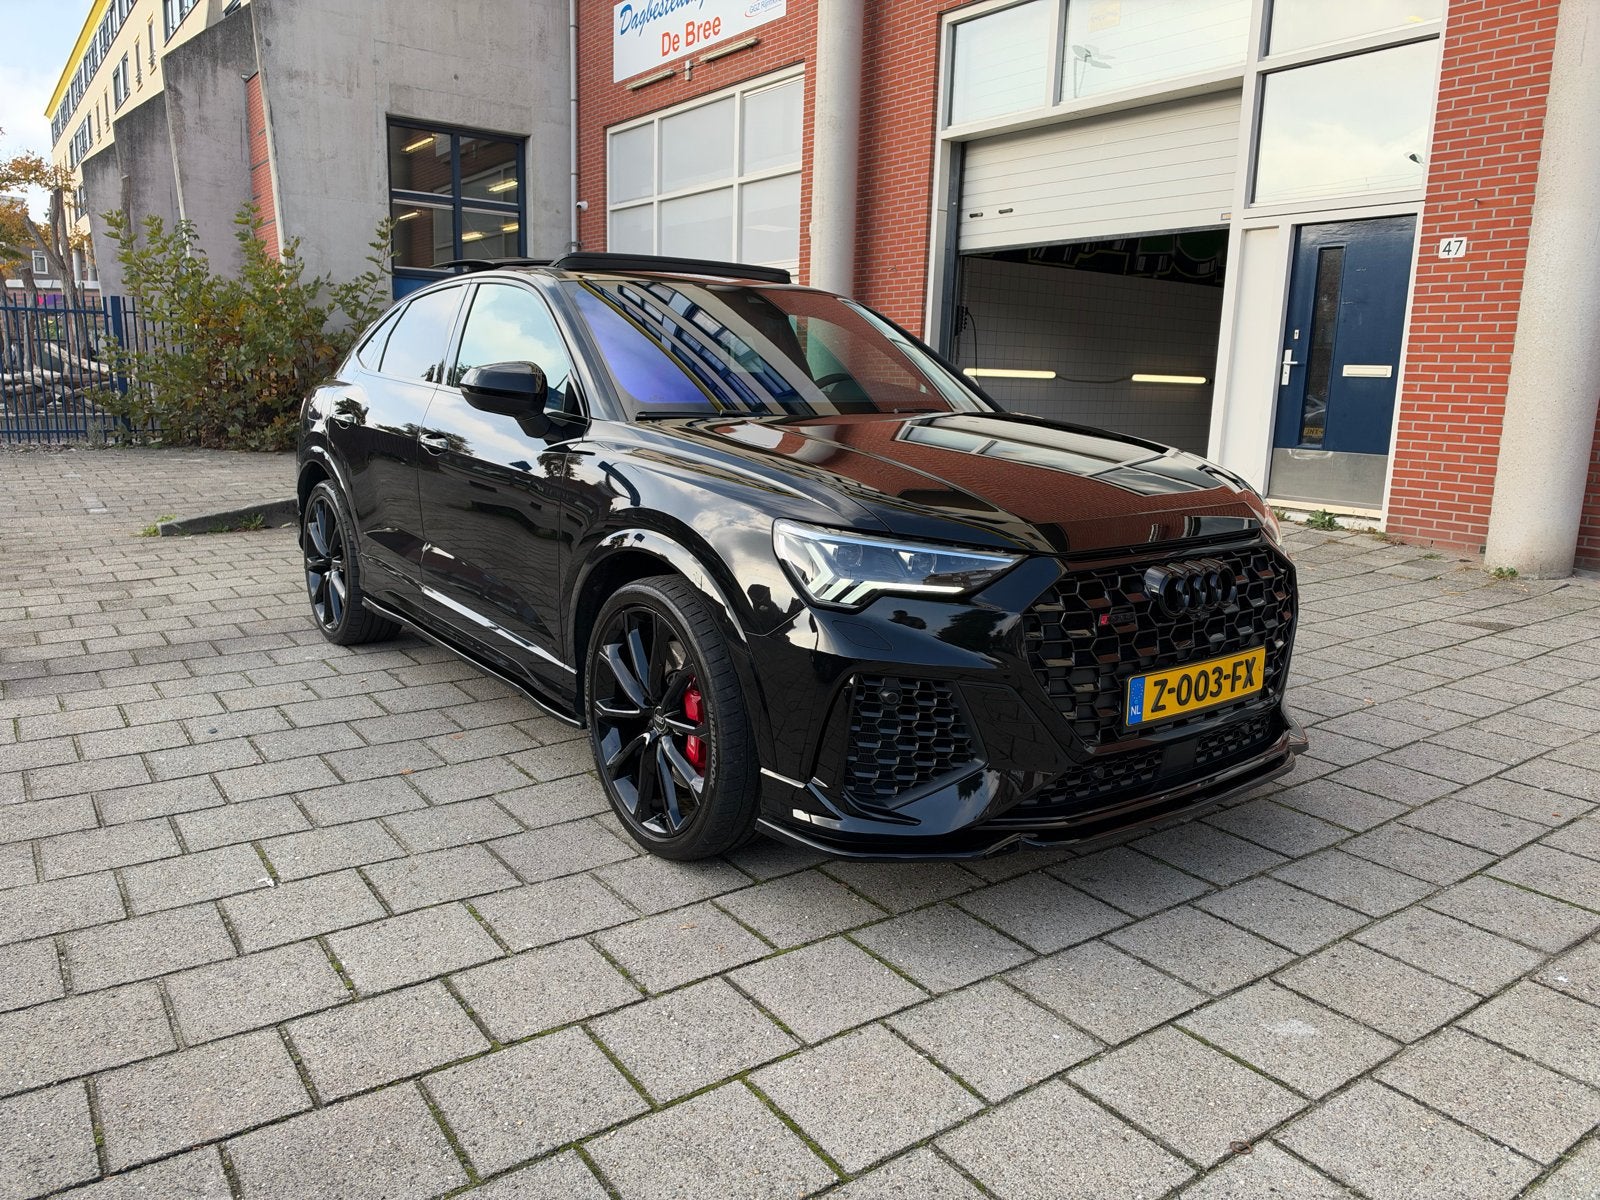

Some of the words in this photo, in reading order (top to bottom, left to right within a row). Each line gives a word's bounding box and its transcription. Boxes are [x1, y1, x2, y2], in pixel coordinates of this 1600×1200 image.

[661, 32, 680, 56] De
[685, 16, 721, 47] Bree
[1442, 239, 1464, 256] 47
[1151, 656, 1256, 713] Z-003-FX
[1130, 706, 1142, 716] NL
